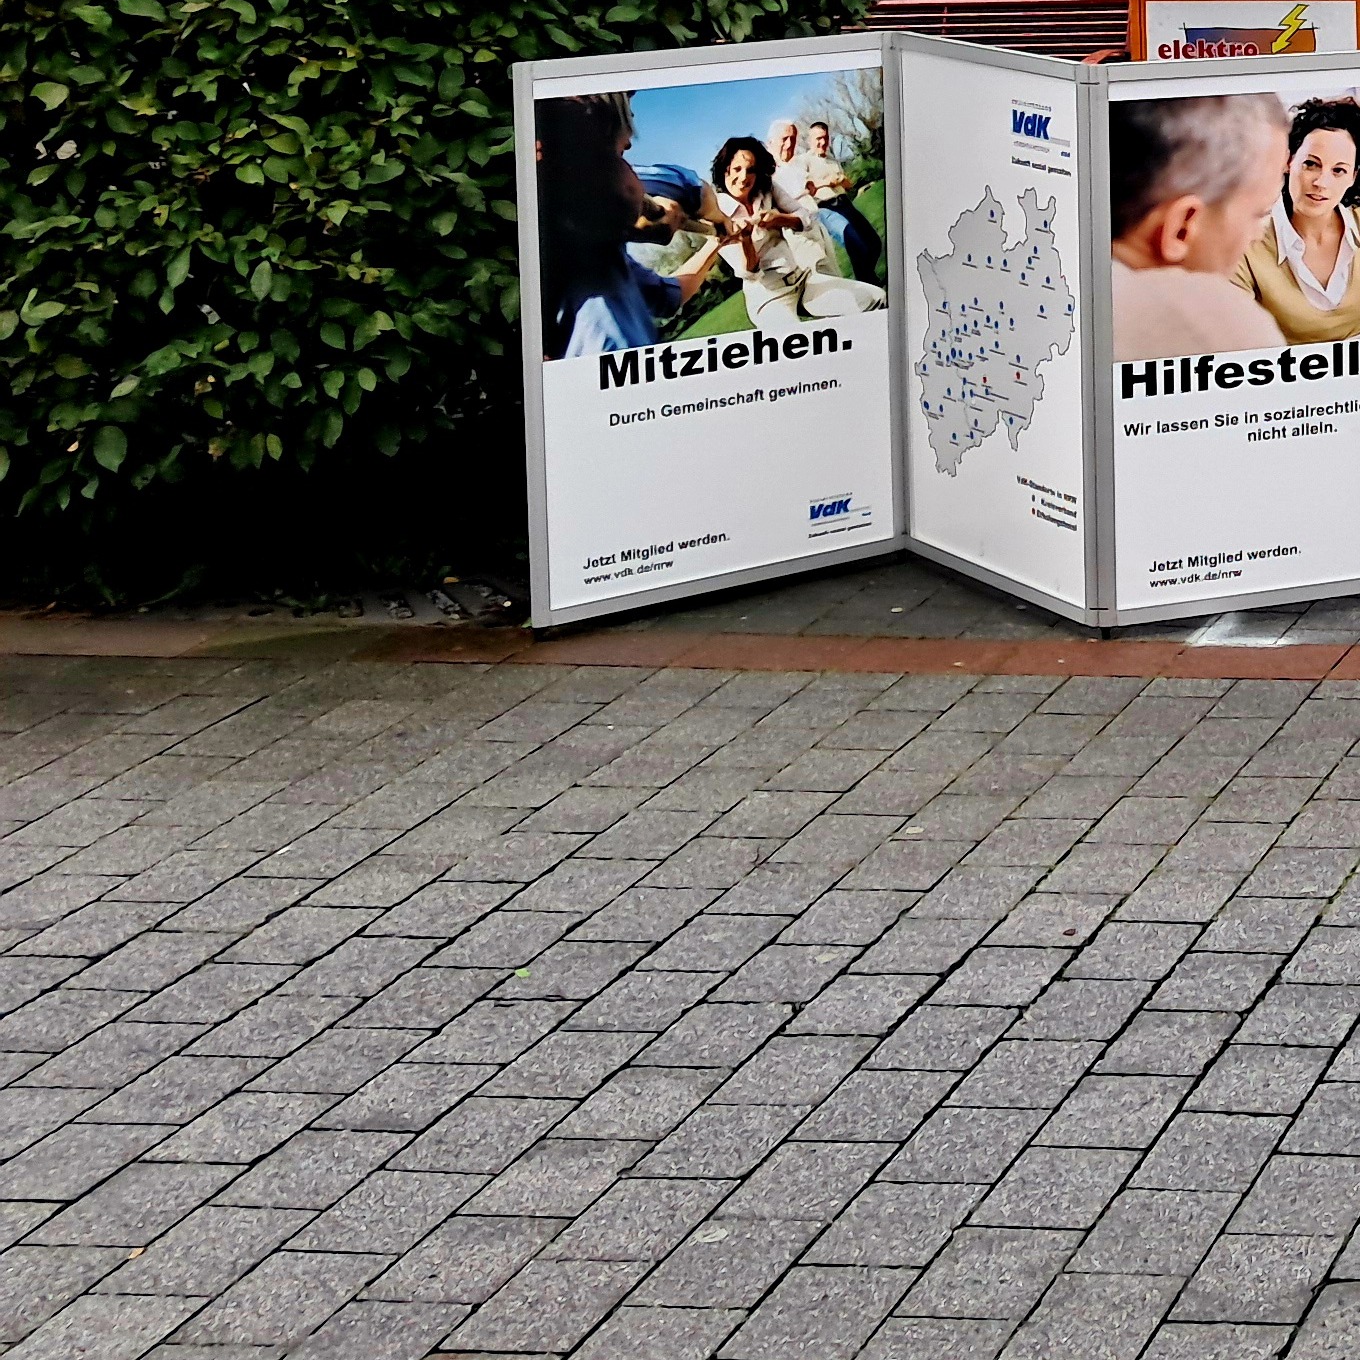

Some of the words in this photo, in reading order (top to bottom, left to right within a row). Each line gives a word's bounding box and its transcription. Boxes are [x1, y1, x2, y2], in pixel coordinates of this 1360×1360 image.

[1158, 40, 1259, 59] elektro
[1012, 109, 1051, 140] VdK
[599, 328, 852, 390] Mitziehen.
[609, 409, 655, 427] Durch
[661, 388, 764, 418] Gemeinschaft
[769, 378, 842, 401] gewinnen.
[1124, 423, 1152, 437] Wir
[1157, 417, 1209, 435] lassen
[1214, 413, 1239, 428] Sie
[1244, 411, 1258, 424] in
[1247, 425, 1287, 442] nicht
[1292, 421, 1338, 438] allein.
[810, 498, 852, 520] VdK
[583, 554, 616, 569] Jetzt
[621, 541, 674, 561] Mitglied
[678, 533, 730, 550] werden.
[1149, 559, 1182, 572] Jetzt
[1188, 551, 1243, 568] Mitglied
[1247, 545, 1301, 560] werden.
[1149, 569, 1242, 587] www.vdk.de/nrw
